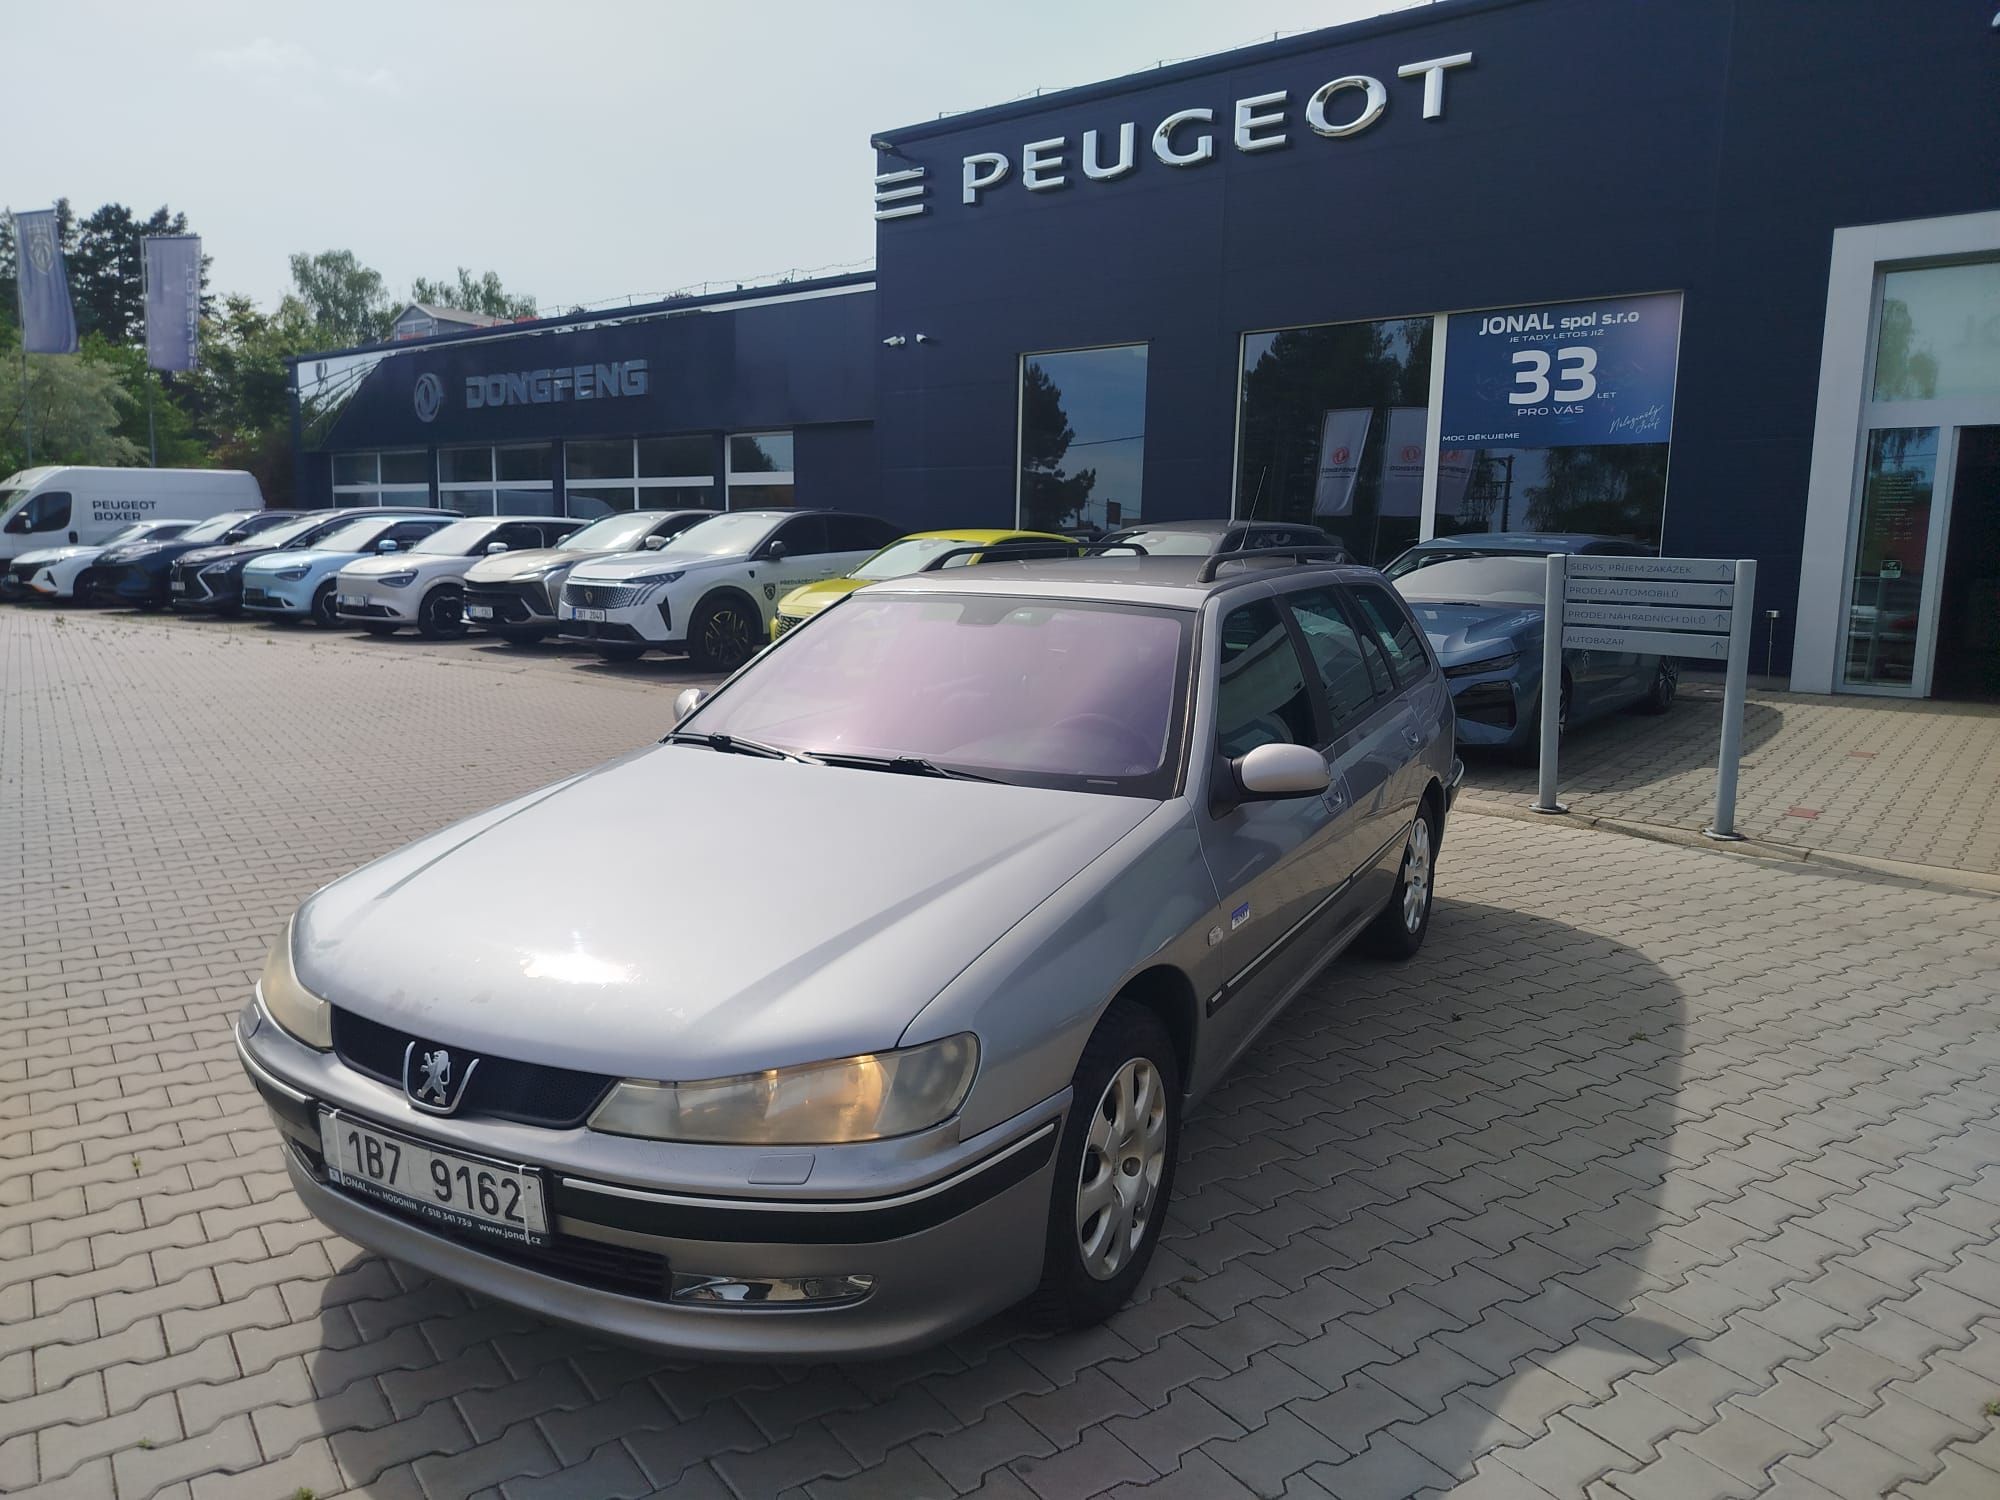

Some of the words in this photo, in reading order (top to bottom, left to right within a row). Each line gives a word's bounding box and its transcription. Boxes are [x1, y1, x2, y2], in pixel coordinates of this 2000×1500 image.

[962, 51, 1473, 204] PEUGEOT
[1478, 312, 1555, 336] JONAL
[1560, 311, 1597, 330] spol
[1601, 311, 1640, 325] s.r.o
[1522, 334, 1551, 342] TADY
[1553, 331, 1589, 340] LETOS
[1508, 346, 1598, 405] 33
[466, 359, 649, 409] DONGFENG
[1517, 407, 1549, 417] PRO
[1553, 404, 1584, 415] VÁS
[92, 500, 157, 510] PEUGEOT
[94, 512, 141, 520] BOXER
[1569, 586, 1608, 595] PRODEJ
[1568, 610, 1607, 619] PRODEJ
[1566, 635, 1625, 647] AUTOBAZAR
[348, 1131, 401, 1185] 1B7
[430, 1159, 526, 1224] 9162
